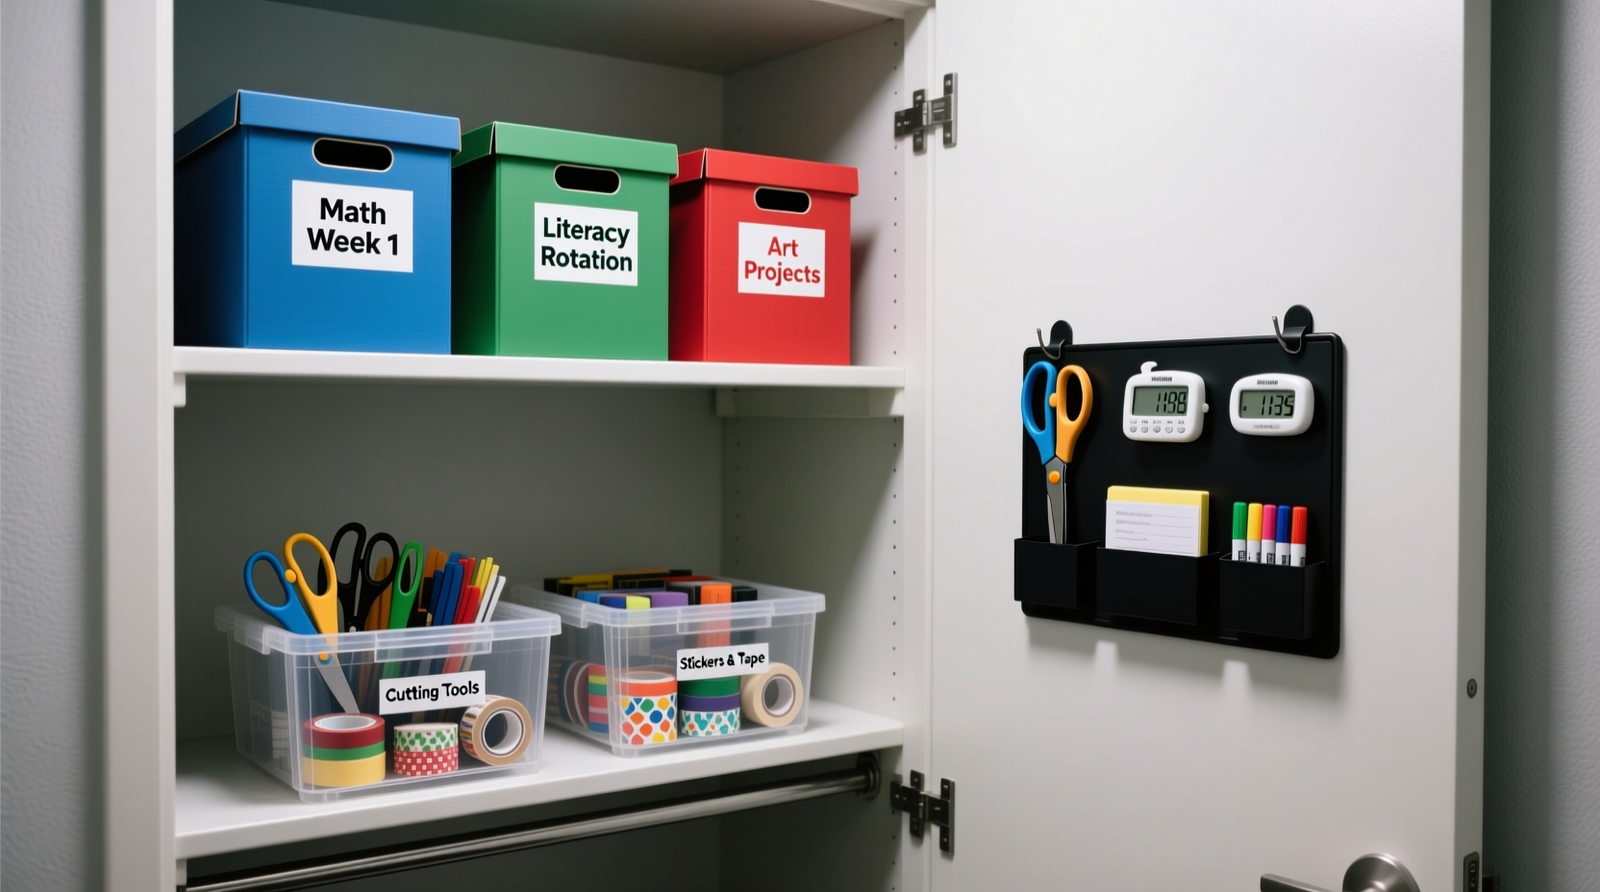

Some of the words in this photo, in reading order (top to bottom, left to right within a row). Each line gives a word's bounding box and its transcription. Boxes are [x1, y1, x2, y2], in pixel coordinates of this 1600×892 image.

[320, 197, 386, 225] Math
[306, 227, 381, 255] Week
[387, 233, 398, 256] 1
[543, 216, 630, 249] Literacy
[541, 245, 632, 272] Rotation
[767, 236, 799, 257] Art
[744, 260, 821, 287] Projects
[1260, 395, 1295, 416] 1135
[679, 655, 725, 670] Stickers
[726, 653, 735, 666] &
[737, 651, 766, 669] Tape
[385, 684, 439, 702] Cutting
[441, 680, 480, 697] Tools
